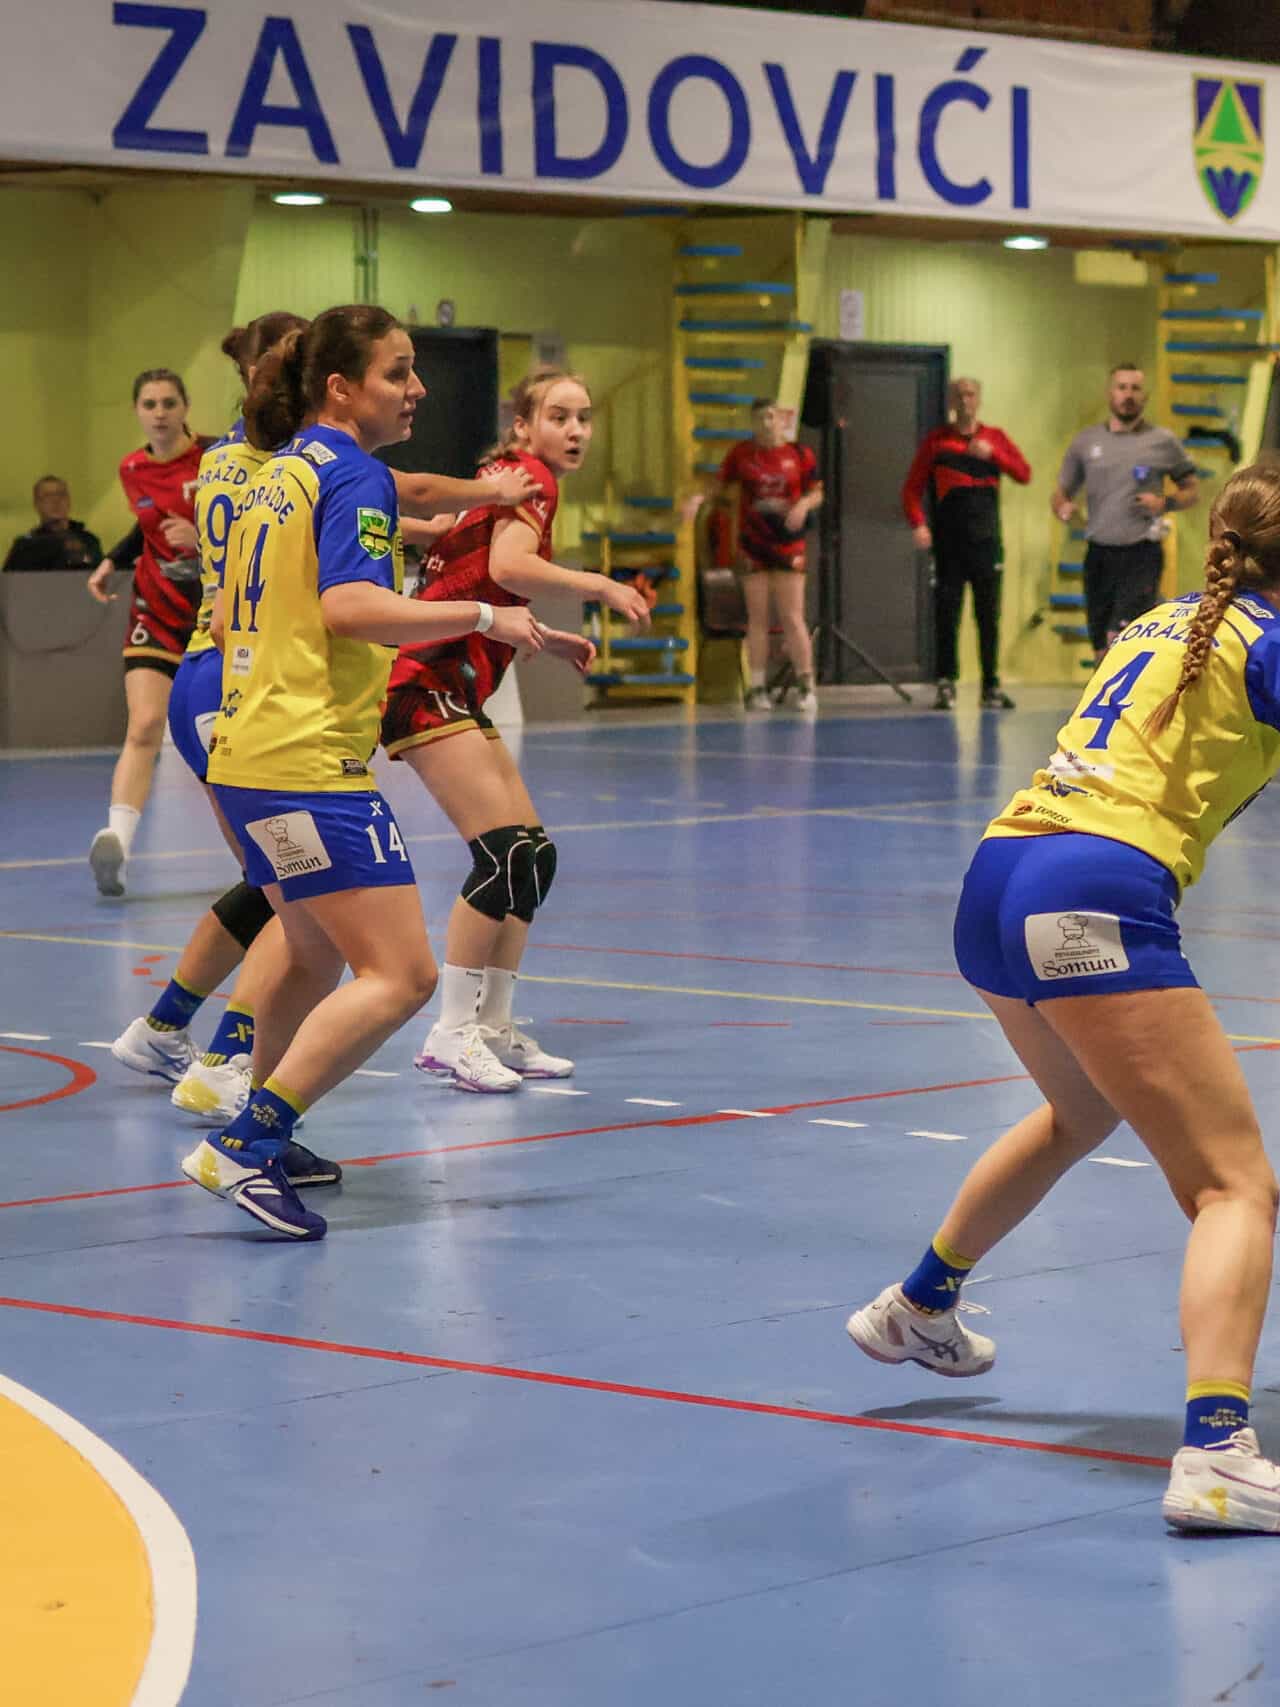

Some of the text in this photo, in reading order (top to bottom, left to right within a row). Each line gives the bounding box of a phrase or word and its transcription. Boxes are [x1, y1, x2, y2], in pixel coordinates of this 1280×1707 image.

[113, 2, 1030, 209] ZAVIDOVIĆI
[131, 619, 150, 646] 6
[1080, 650, 1155, 750] 4
[364, 822, 409, 864] 14
[1042, 958, 1118, 978] Somun
